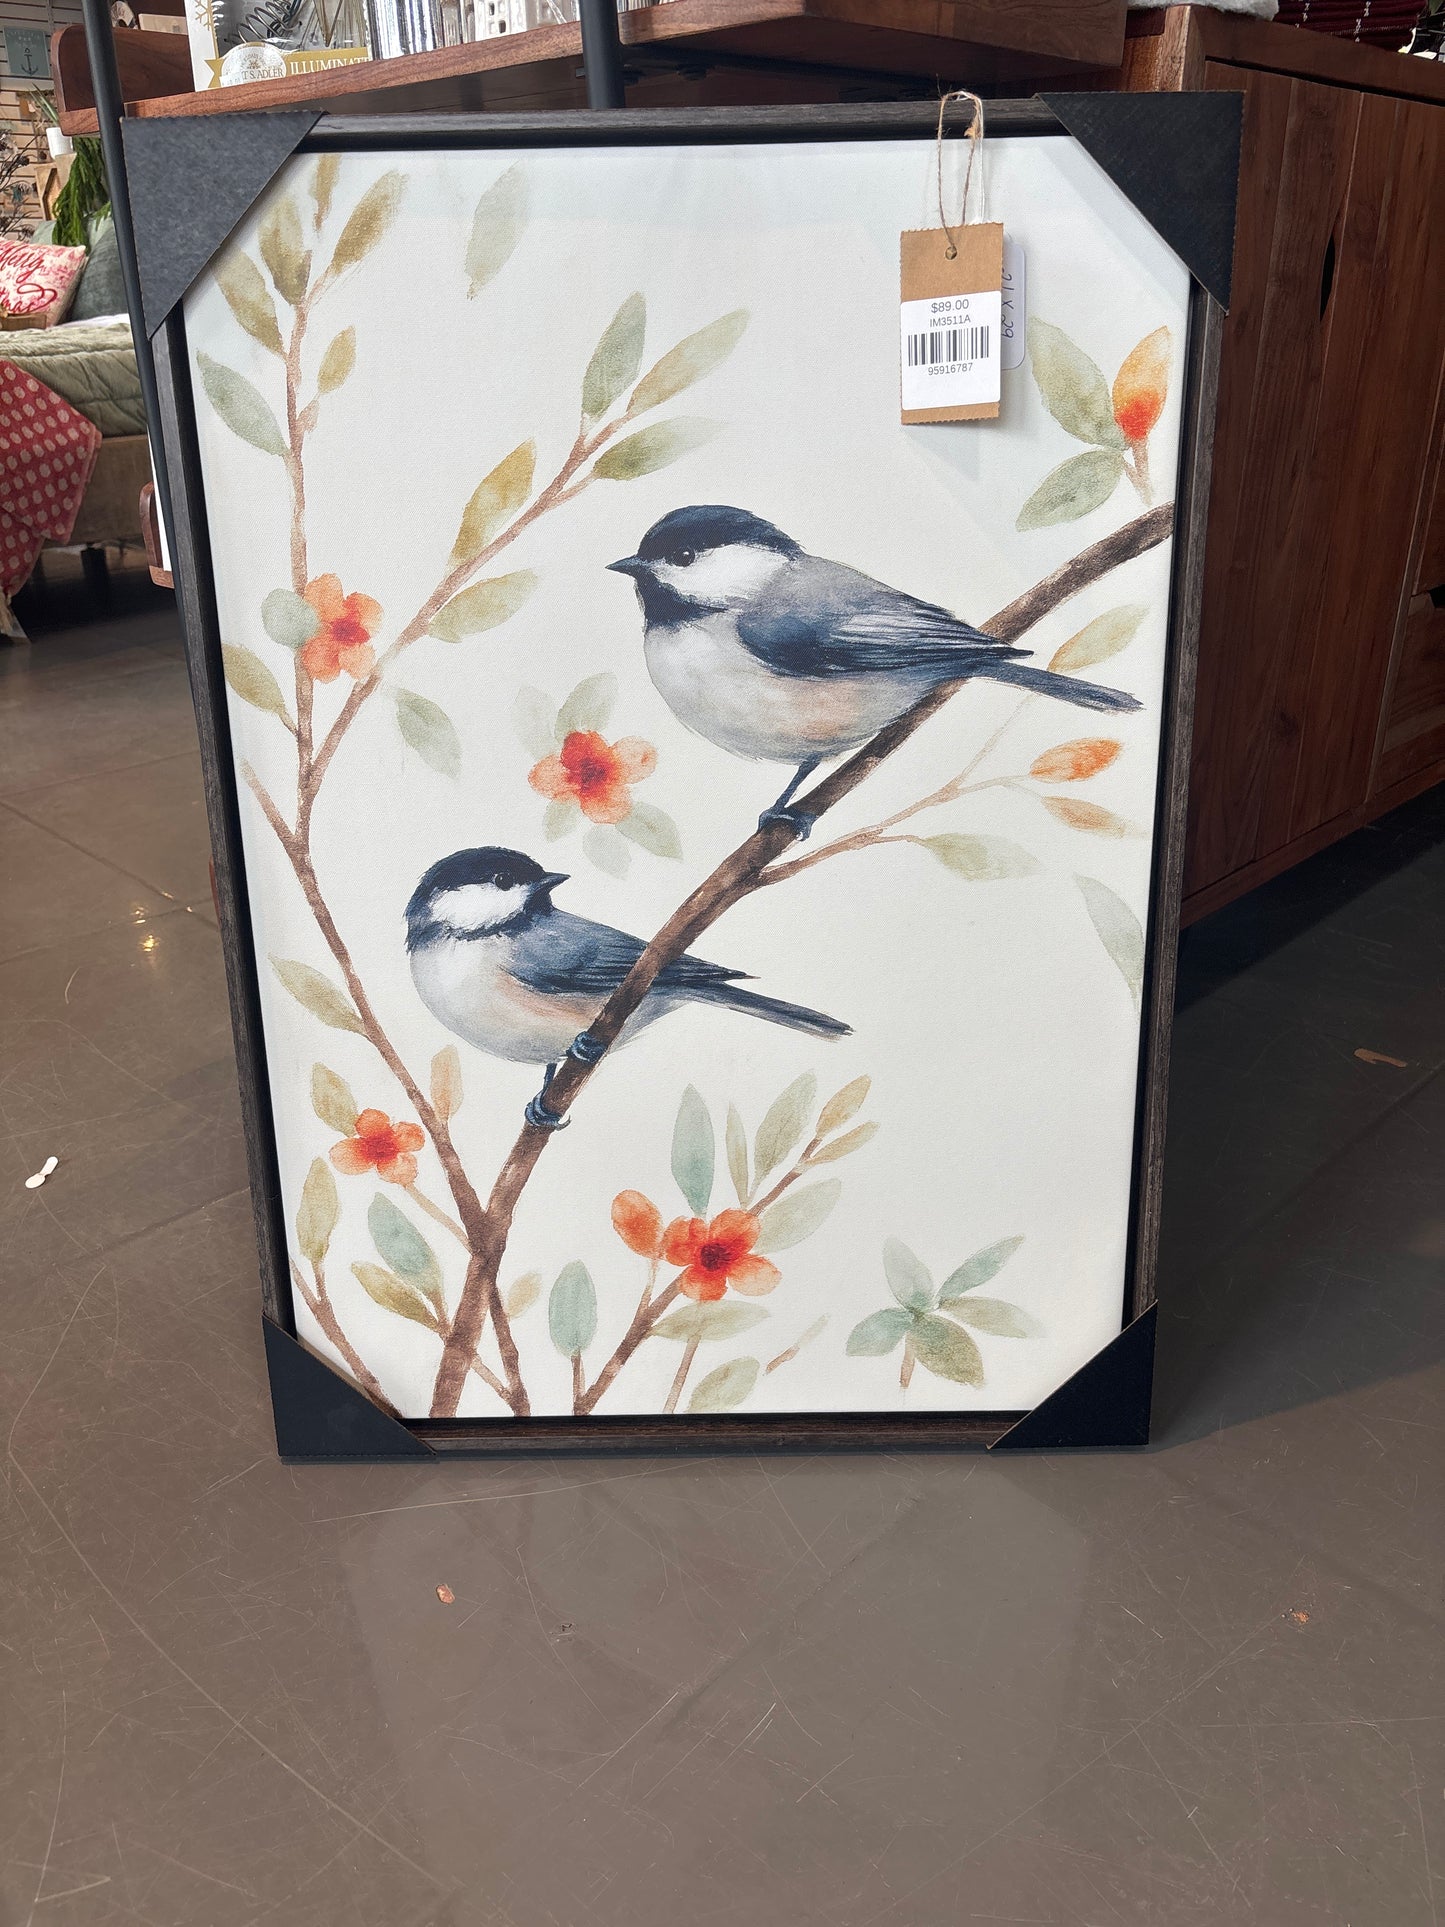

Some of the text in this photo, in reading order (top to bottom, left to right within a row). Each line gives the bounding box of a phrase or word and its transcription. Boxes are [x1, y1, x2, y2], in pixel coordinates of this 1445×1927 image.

[257, 68, 284, 79] ADLER
[930, 298, 970, 314] $89.00
[928, 314, 972, 328] IM3511A
[1001, 314, 1015, 339] 29
[927, 362, 974, 377] 95916787
